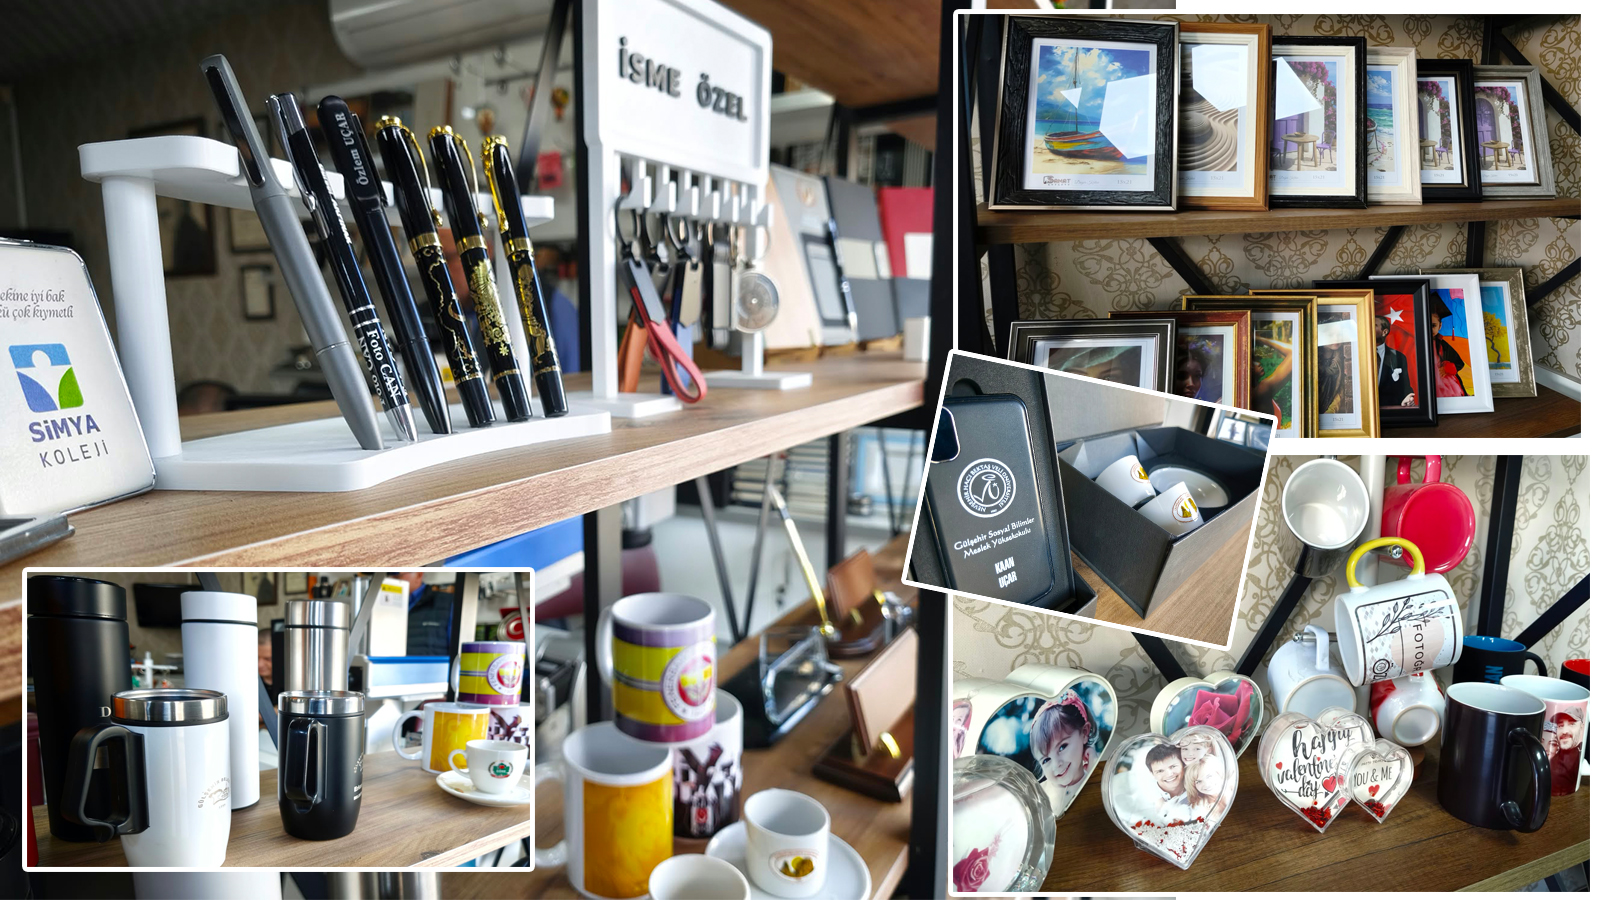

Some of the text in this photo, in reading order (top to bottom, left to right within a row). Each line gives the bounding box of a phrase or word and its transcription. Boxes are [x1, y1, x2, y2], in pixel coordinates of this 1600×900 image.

[618, 36, 748, 122] İSME ÖZEL
[335, 112, 355, 146] UÇAR
[351, 148, 369, 185] Özlem
[0, 288, 65, 304] ekine iyi bak
[12, 304, 31, 321] çok
[32, 304, 74, 321] kıymetli
[366, 328, 384, 361] Foto
[380, 363, 402, 398] CAN
[39, 439, 109, 468] KOLEJİ
[963, 473, 973, 491] HACI
[954, 517, 1035, 550] Gülşehir Sosyal Bilimler
[963, 527, 1032, 559] Meslek Yüksekokulu
[994, 556, 1015, 575] KAAN
[998, 570, 1018, 589] UÇAR
[1412, 623, 1425, 673] FOTOĞR
[99, 706, 111, 718] D
[1298, 775, 1321, 800] day
[1353, 766, 1393, 788] YOU & ME
